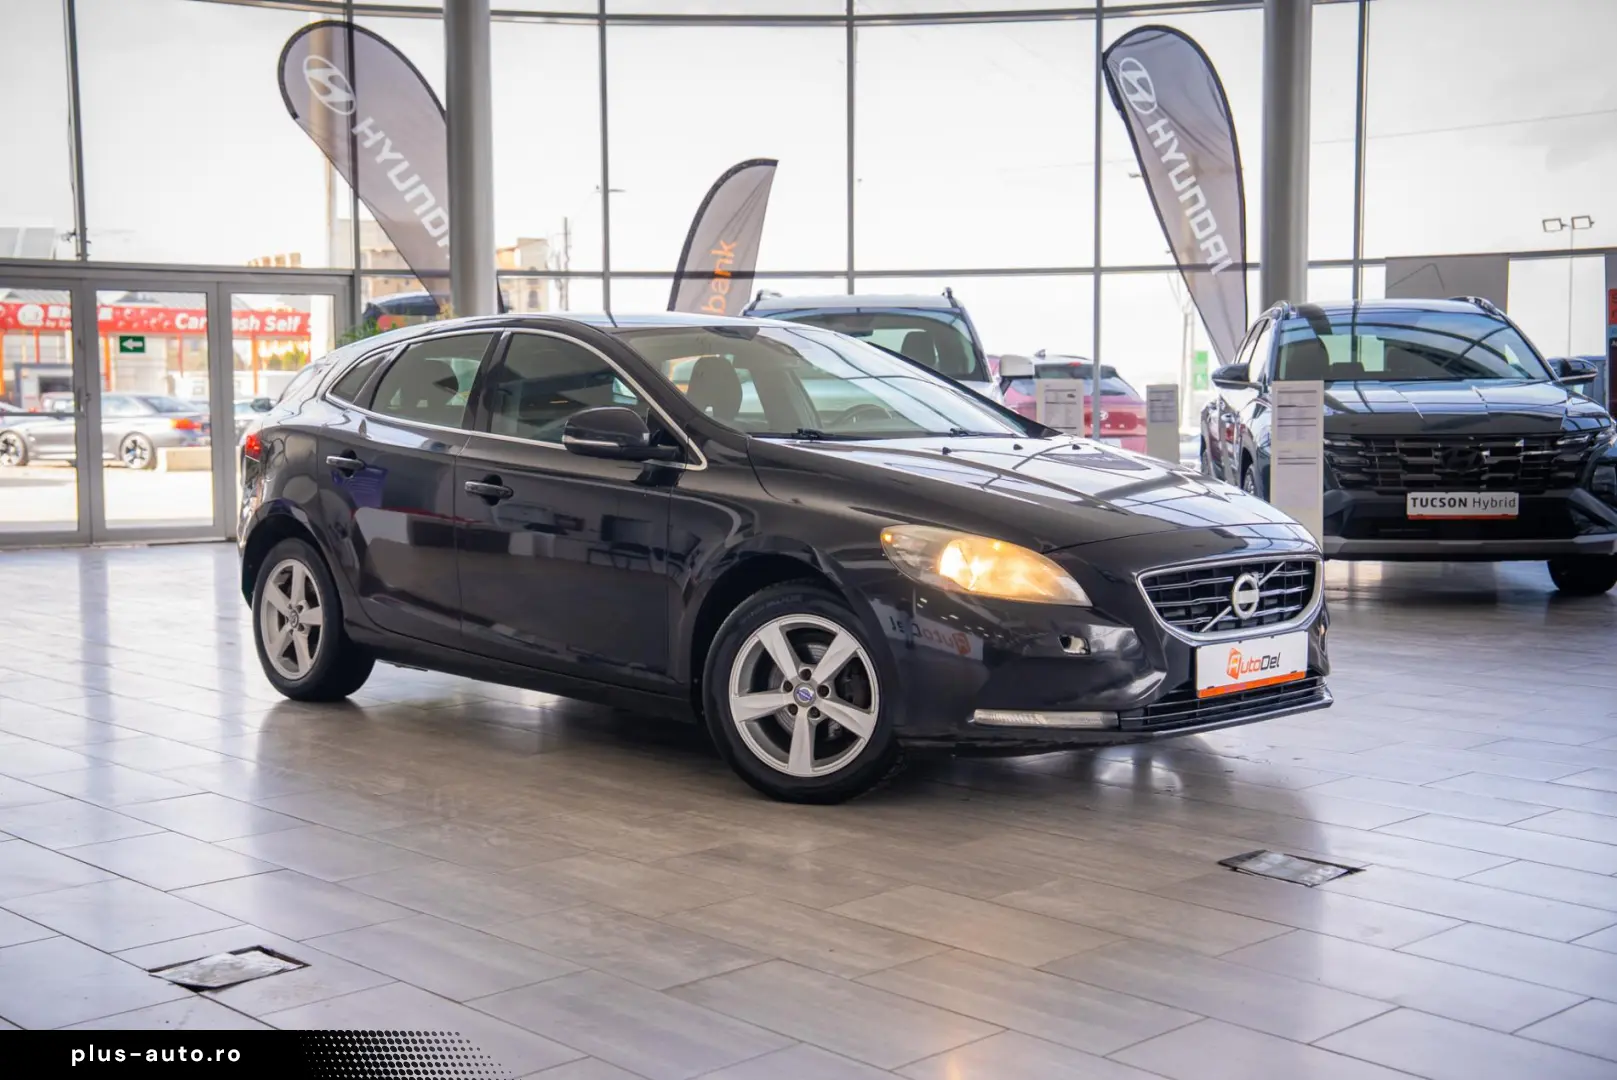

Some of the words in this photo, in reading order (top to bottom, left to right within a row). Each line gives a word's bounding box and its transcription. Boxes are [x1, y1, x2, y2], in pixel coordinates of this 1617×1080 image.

[352, 117, 449, 252] HYUND
[1146, 118, 1233, 275] HYUNDAI
[701, 240, 737, 314] bank
[175, 312, 207, 330] Car
[232, 315, 260, 331] ash
[265, 316, 301, 332] Self
[1411, 497, 1468, 508] TUCSON
[1472, 497, 1516, 511] Hybrid
[1227, 648, 1281, 679] AutoDel
